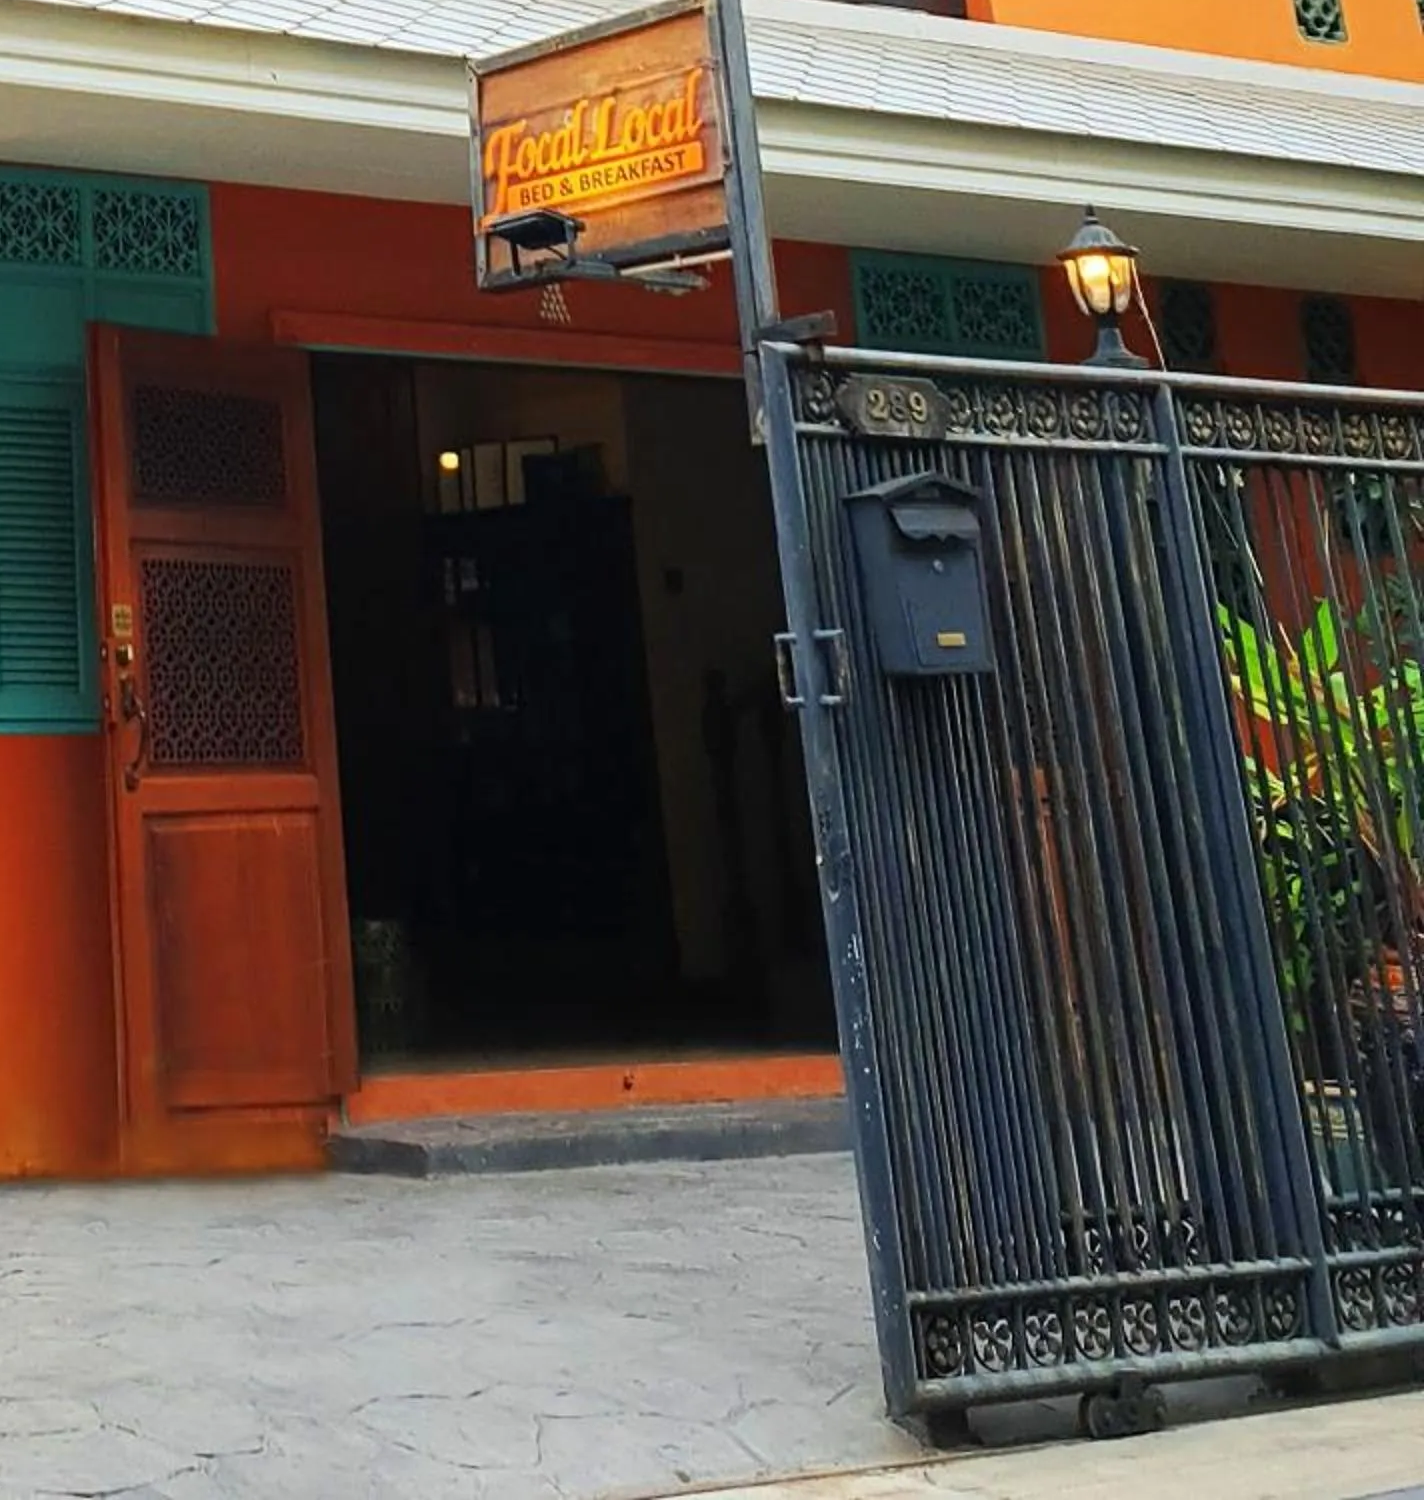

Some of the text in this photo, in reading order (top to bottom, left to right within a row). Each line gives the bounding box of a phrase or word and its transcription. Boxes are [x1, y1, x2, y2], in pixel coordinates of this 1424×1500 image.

[483, 67, 704, 216] Focal Local
[519, 150, 686, 207] BED & BREAKFAST
[868, 390, 927, 422] 289
